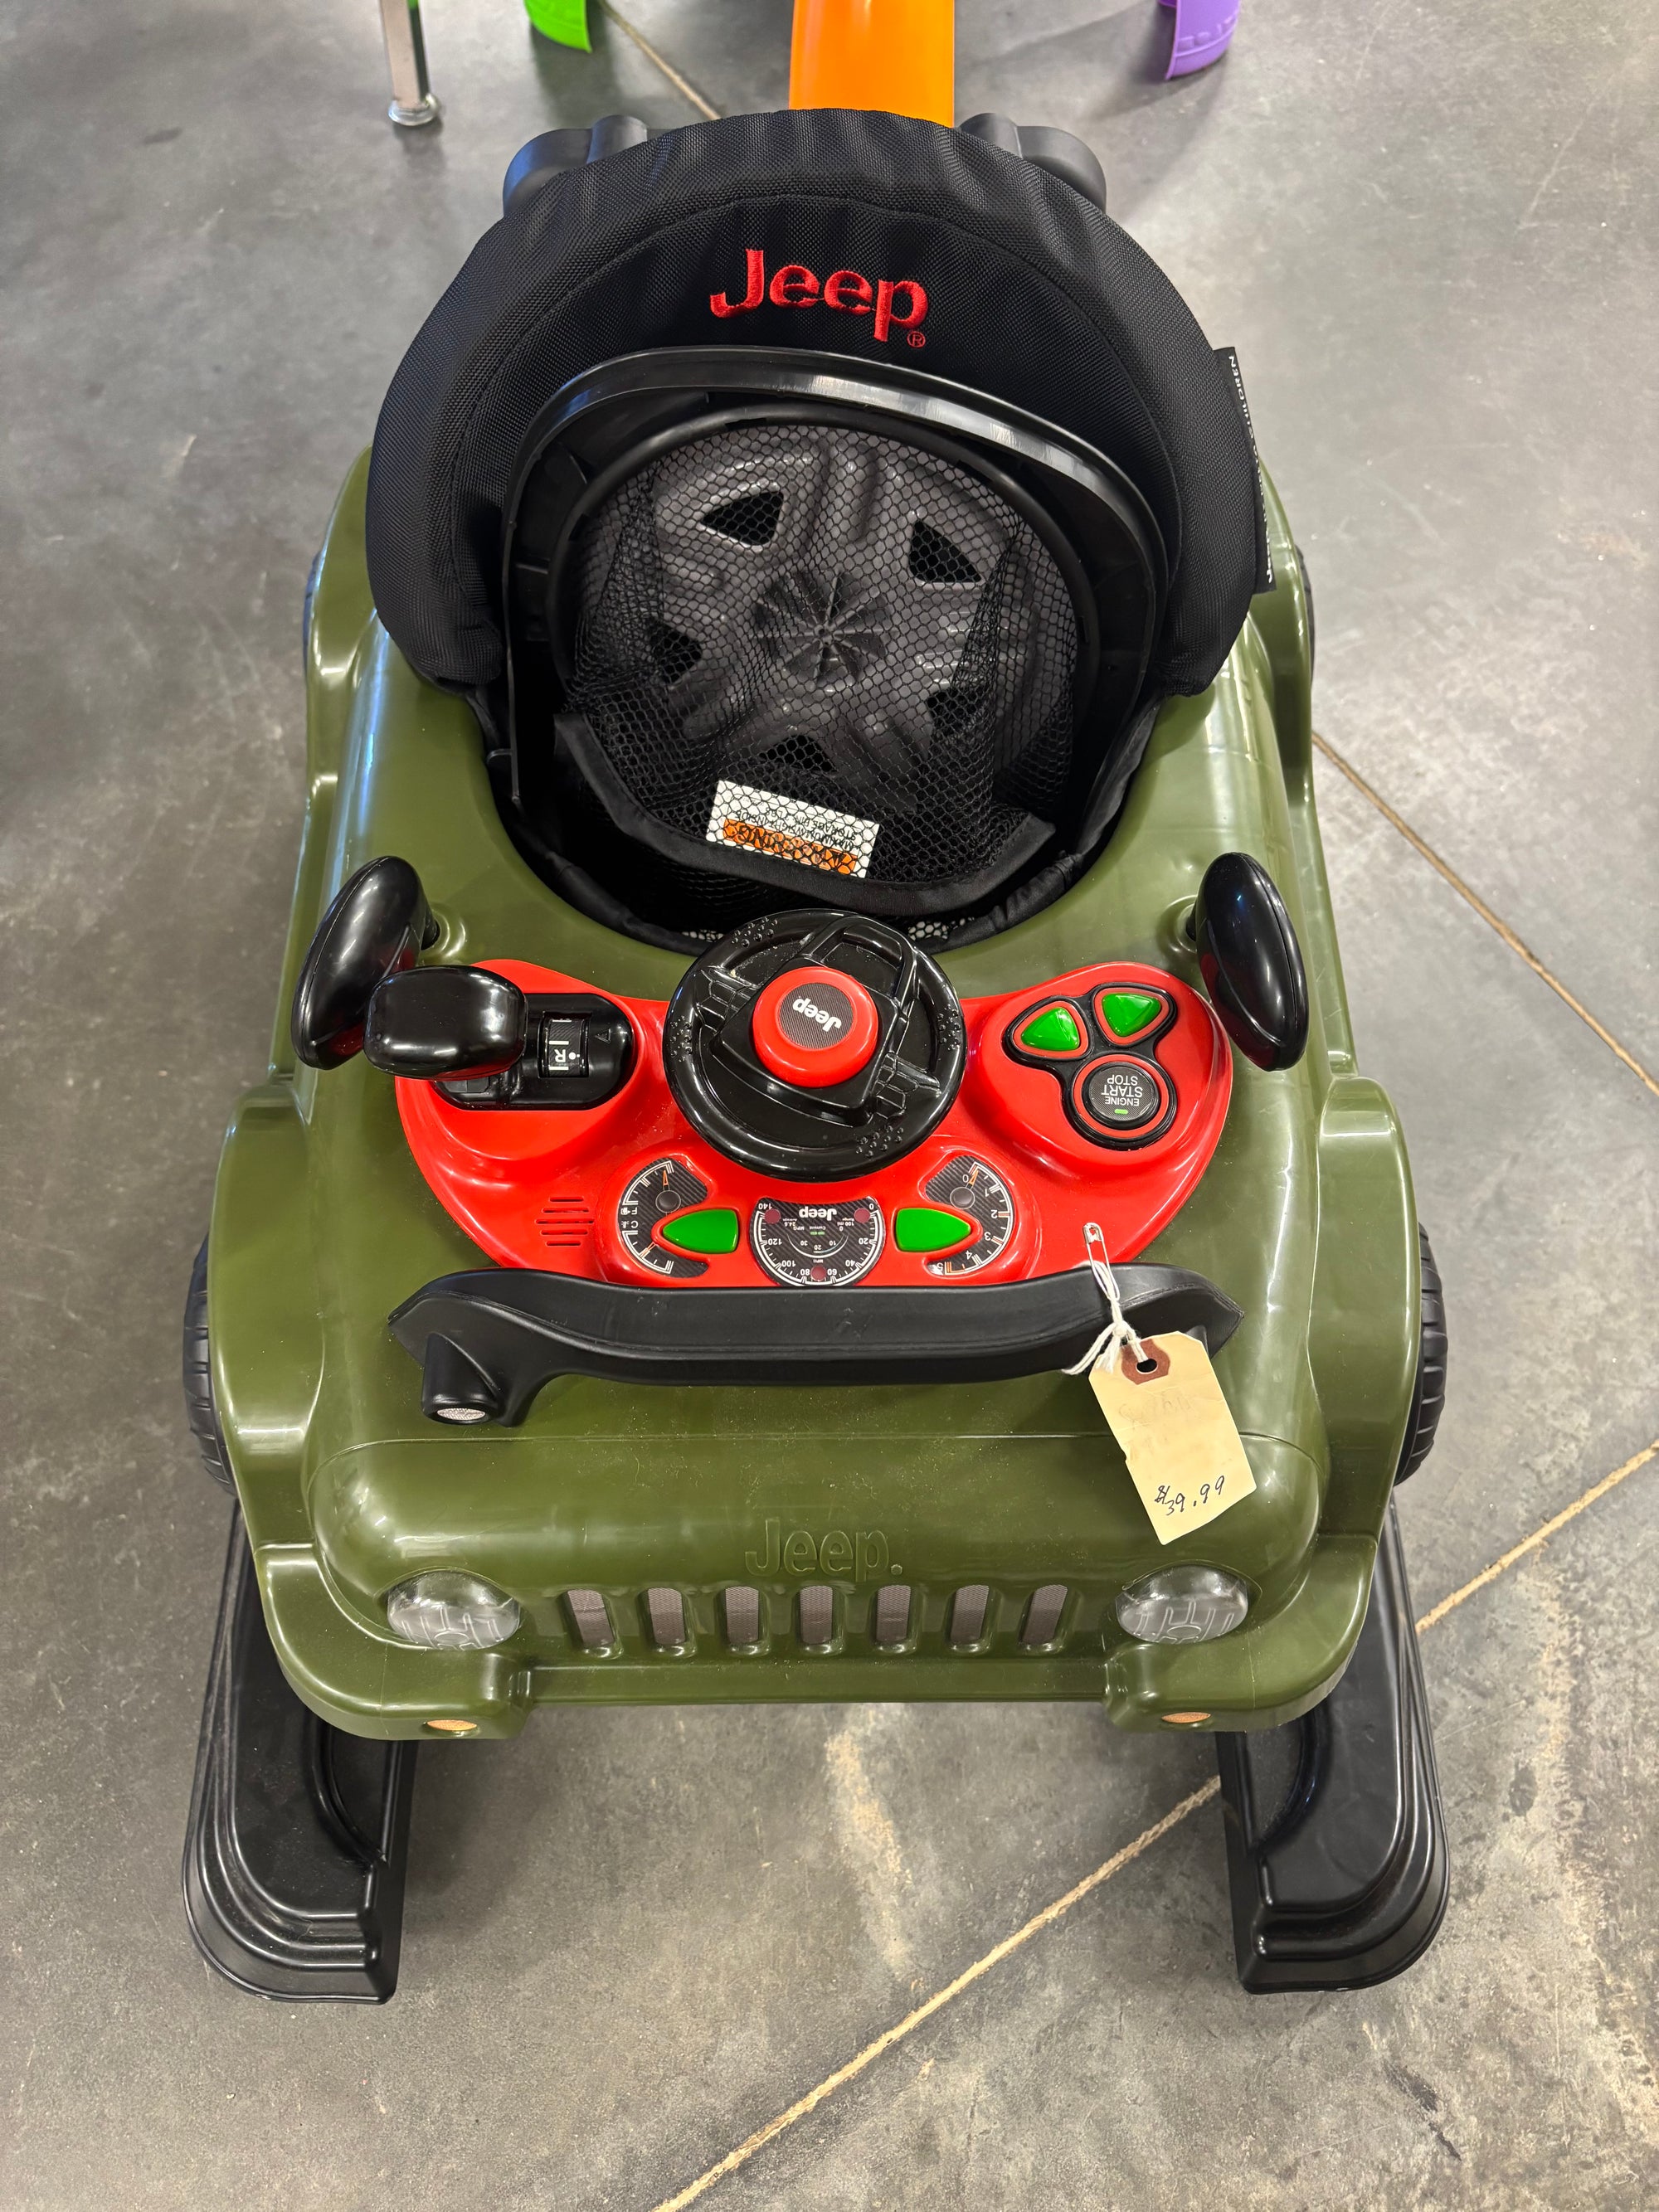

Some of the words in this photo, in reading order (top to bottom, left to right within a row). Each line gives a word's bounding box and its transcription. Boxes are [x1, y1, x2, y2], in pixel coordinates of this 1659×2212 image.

[710, 249, 928, 342] Jeep
[792, 997, 842, 1033] Jeep
[554, 1049, 566, 1062] R
[1107, 1074, 1138, 1086] STOP
[1102, 1084, 1143, 1098] START
[1105, 1096, 1140, 1106] ENGINE
[962, 1174, 970, 1183] 0
[985, 1188, 990, 1198] 1
[631, 1207, 638, 1215] F
[799, 1206, 837, 1221] Jeep
[990, 1209, 998, 1218] 2
[630, 1220, 639, 1228] C
[984, 1232, 991, 1241] 3
[966, 1250, 972, 1260] 4
[937, 1262, 944, 1271] 5
[1155, 1475, 1224, 1516] $39.99
